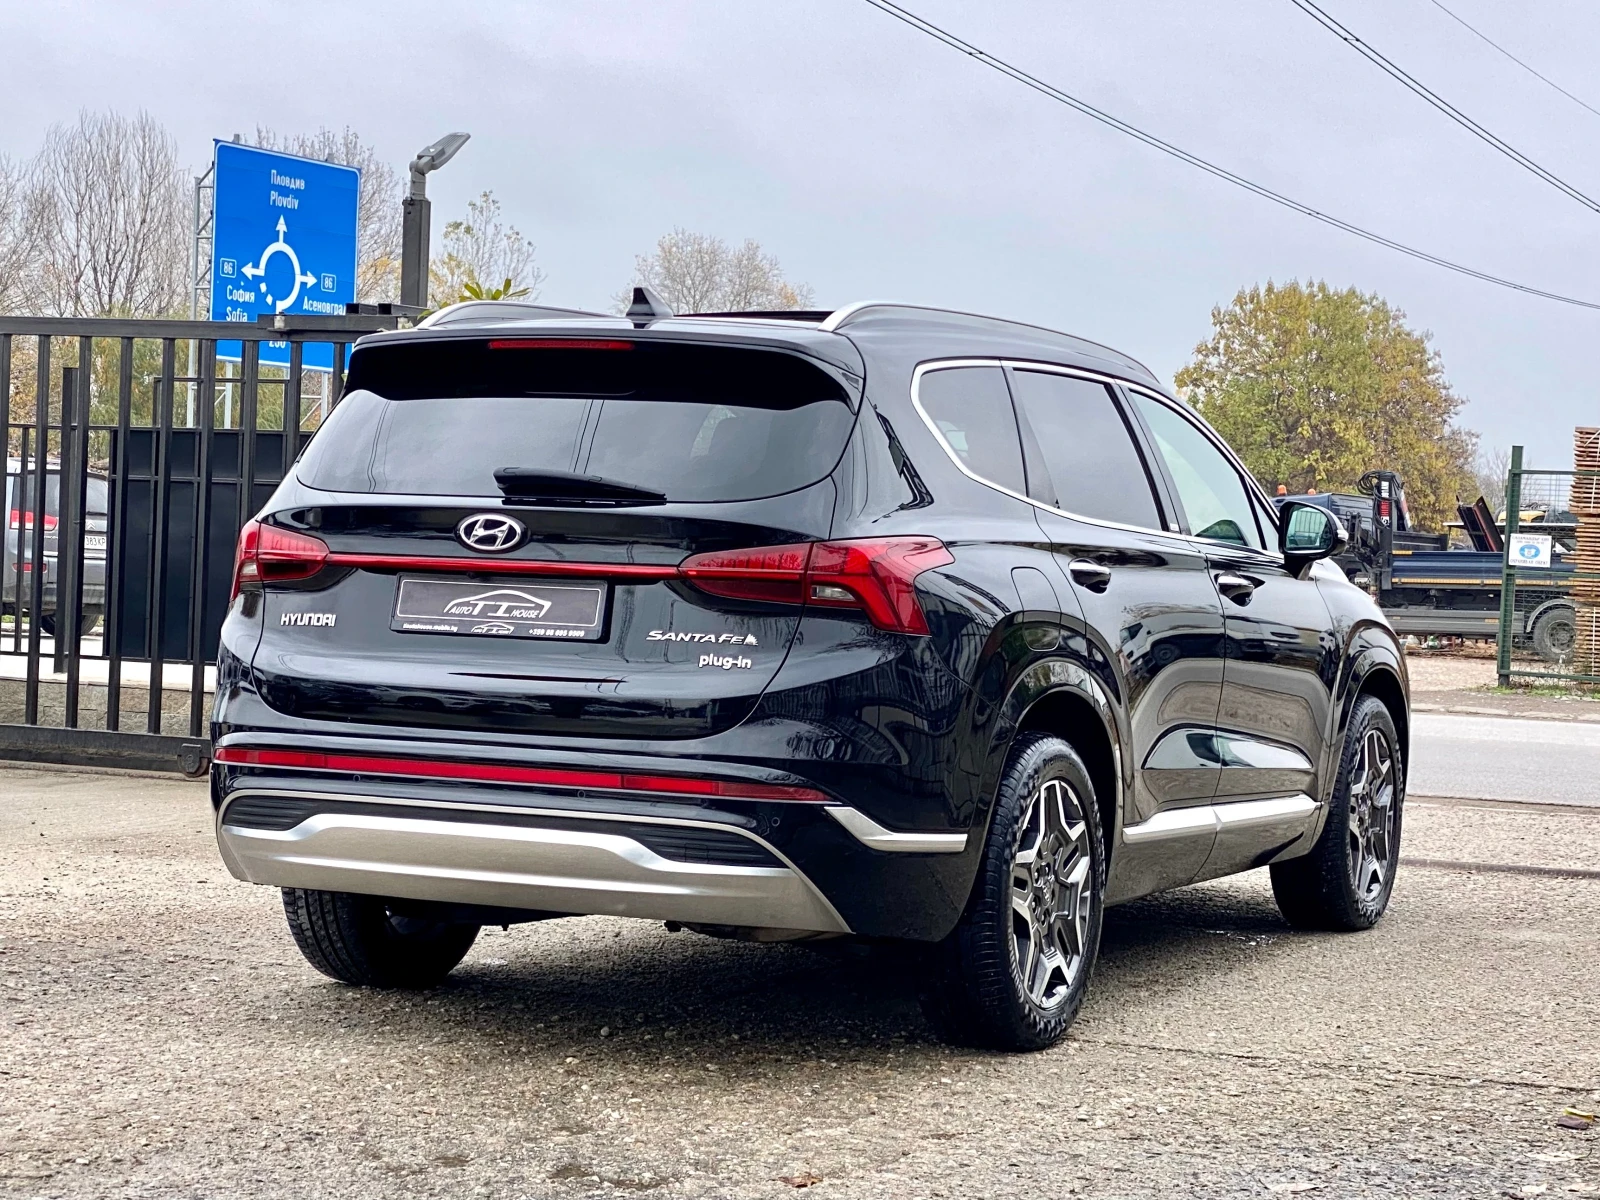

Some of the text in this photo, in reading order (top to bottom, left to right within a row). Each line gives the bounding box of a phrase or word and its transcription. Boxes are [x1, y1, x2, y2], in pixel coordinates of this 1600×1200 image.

[271, 169, 305, 190] Пловдив
[270, 191, 299, 210] Plovdiv
[223, 261, 233, 274] 86
[324, 277, 333, 288] 86
[226, 284, 255, 304] София
[226, 306, 248, 322] Sofia
[449, 606, 473, 614] AUTO
[510, 609, 540, 618] HOUSE
[280, 613, 337, 627] HYUNDAI
[646, 630, 745, 645] SANTA FE
[698, 653, 752, 670] plug-in
